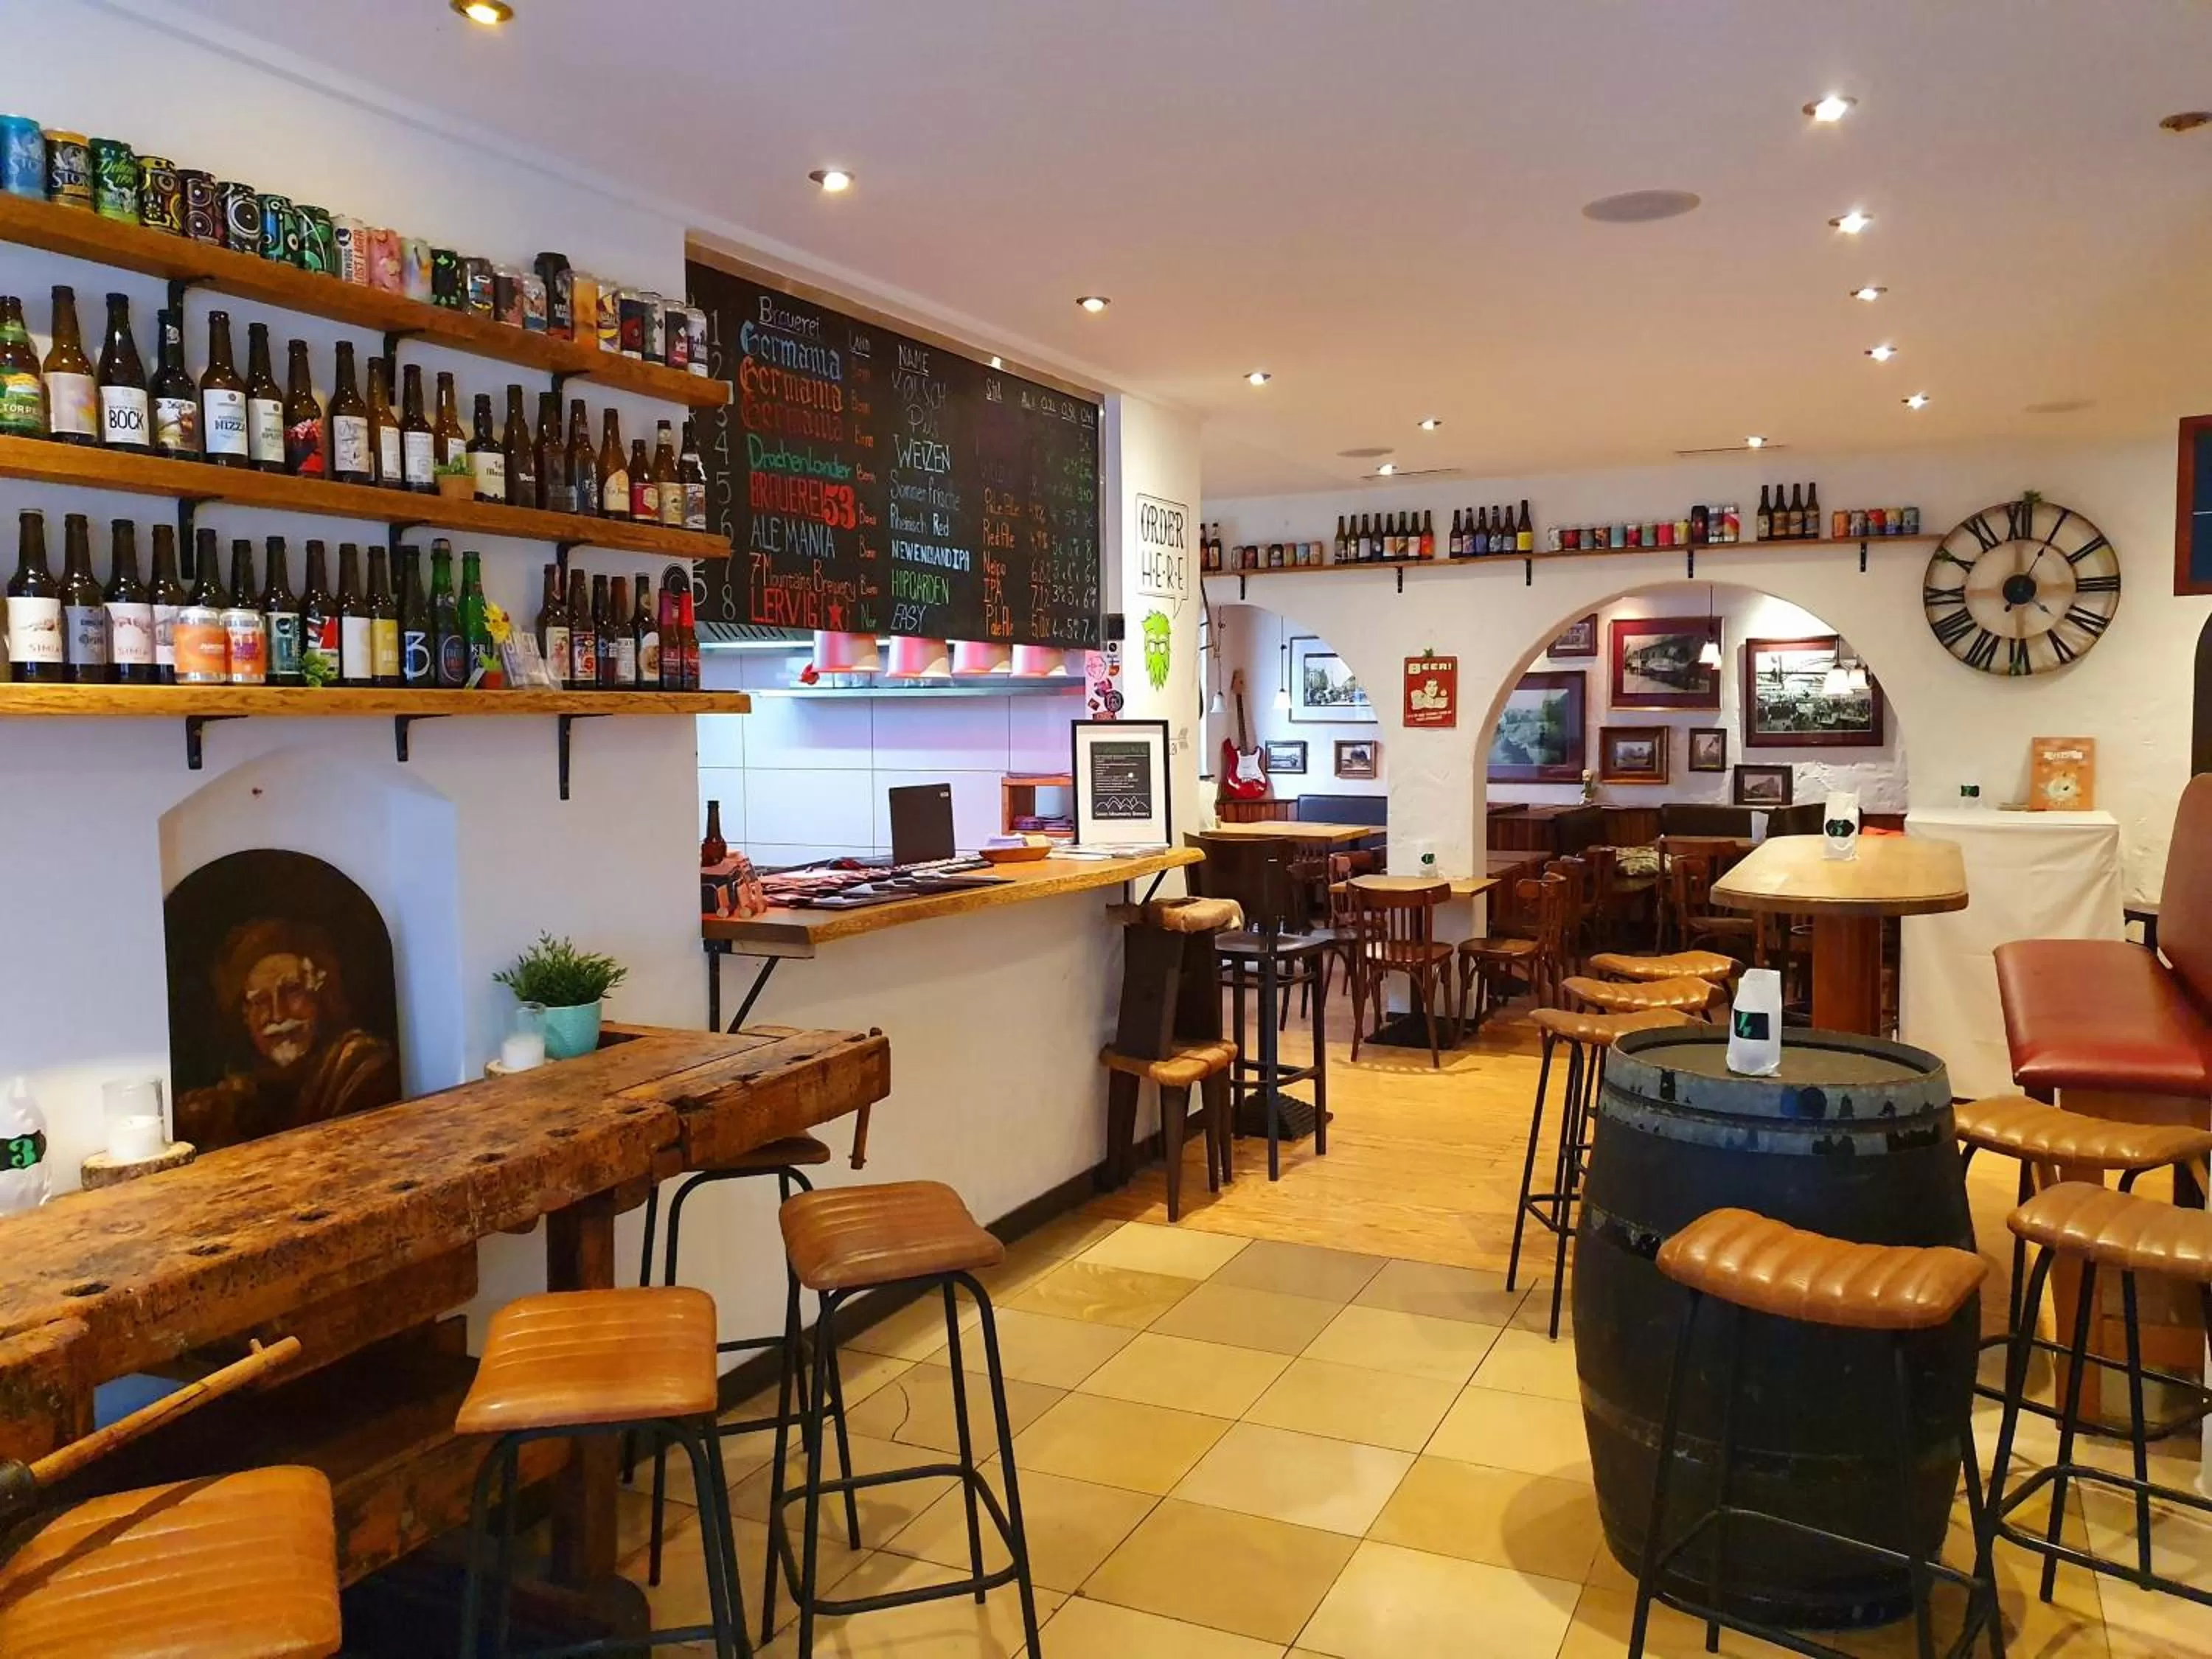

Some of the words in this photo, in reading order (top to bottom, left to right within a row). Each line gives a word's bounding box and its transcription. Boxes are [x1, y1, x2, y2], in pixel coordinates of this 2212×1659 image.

[711, 310, 722, 347] 1
[740, 319, 843, 381] Germania
[898, 344, 930, 372] NAME
[740, 355, 844, 413] Germania
[108, 409, 145, 431] BOCK
[714, 431, 729, 466] 4
[716, 471, 732, 505] 5
[933, 512, 950, 538] Red
[720, 509, 734, 542] 6
[1141, 503, 1183, 549] ORDER
[722, 584, 736, 620] 8
[891, 602, 928, 633] EASY
[8, 1138, 36, 1167] 3
